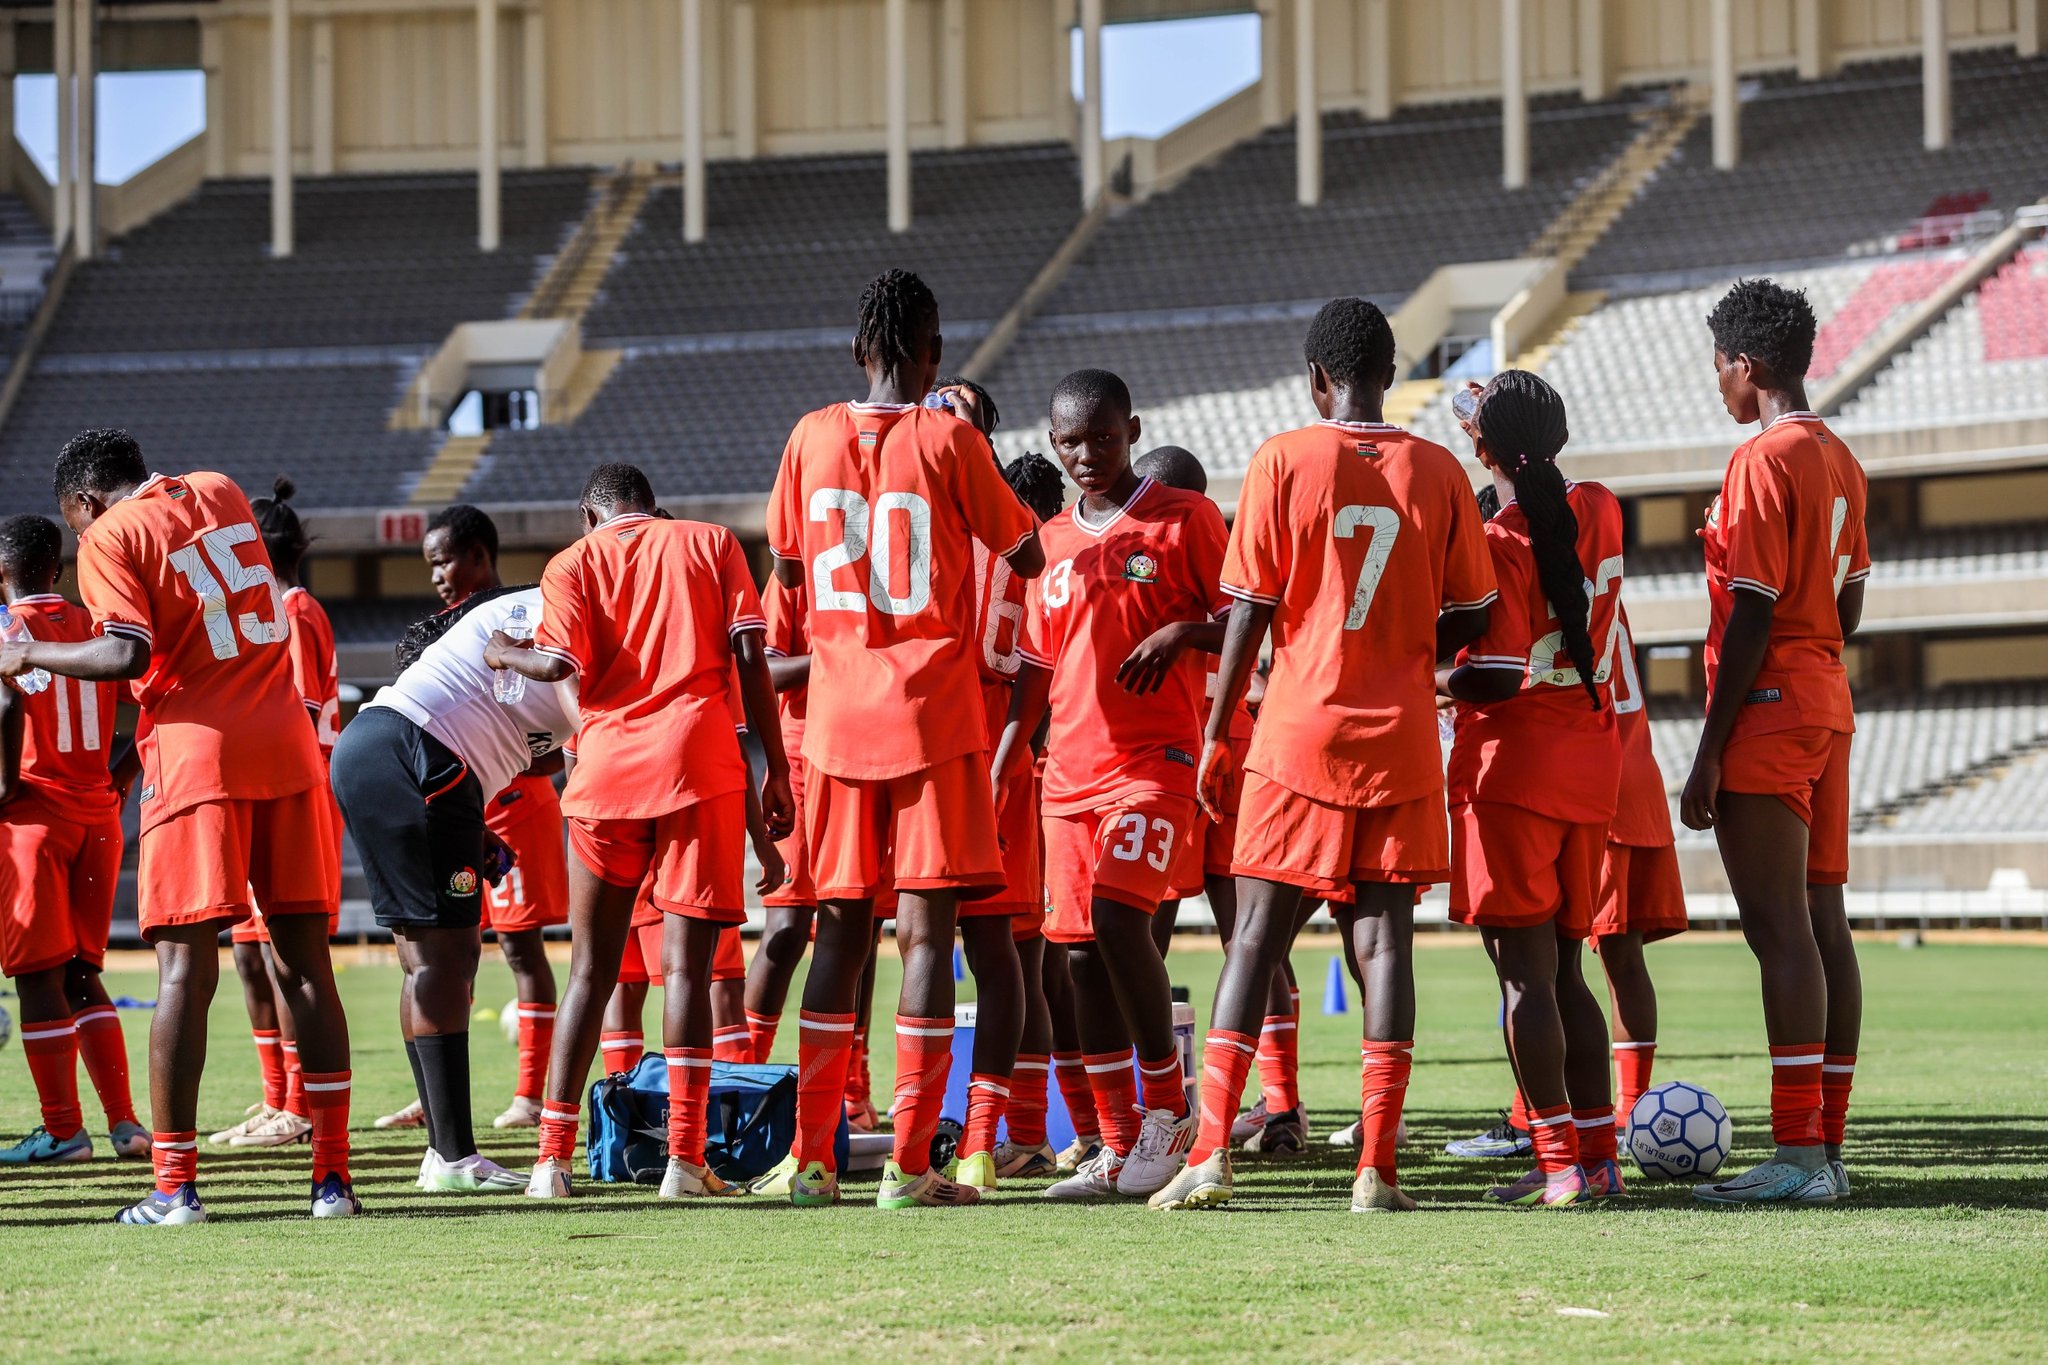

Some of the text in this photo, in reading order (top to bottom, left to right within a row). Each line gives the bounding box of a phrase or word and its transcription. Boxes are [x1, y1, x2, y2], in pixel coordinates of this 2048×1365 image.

[167, 522, 290, 661] 15
[809, 488, 931, 615] 20
[1333, 504, 1401, 631] 7
[55, 672, 101, 753] 11
[1112, 813, 1175, 872] 33
